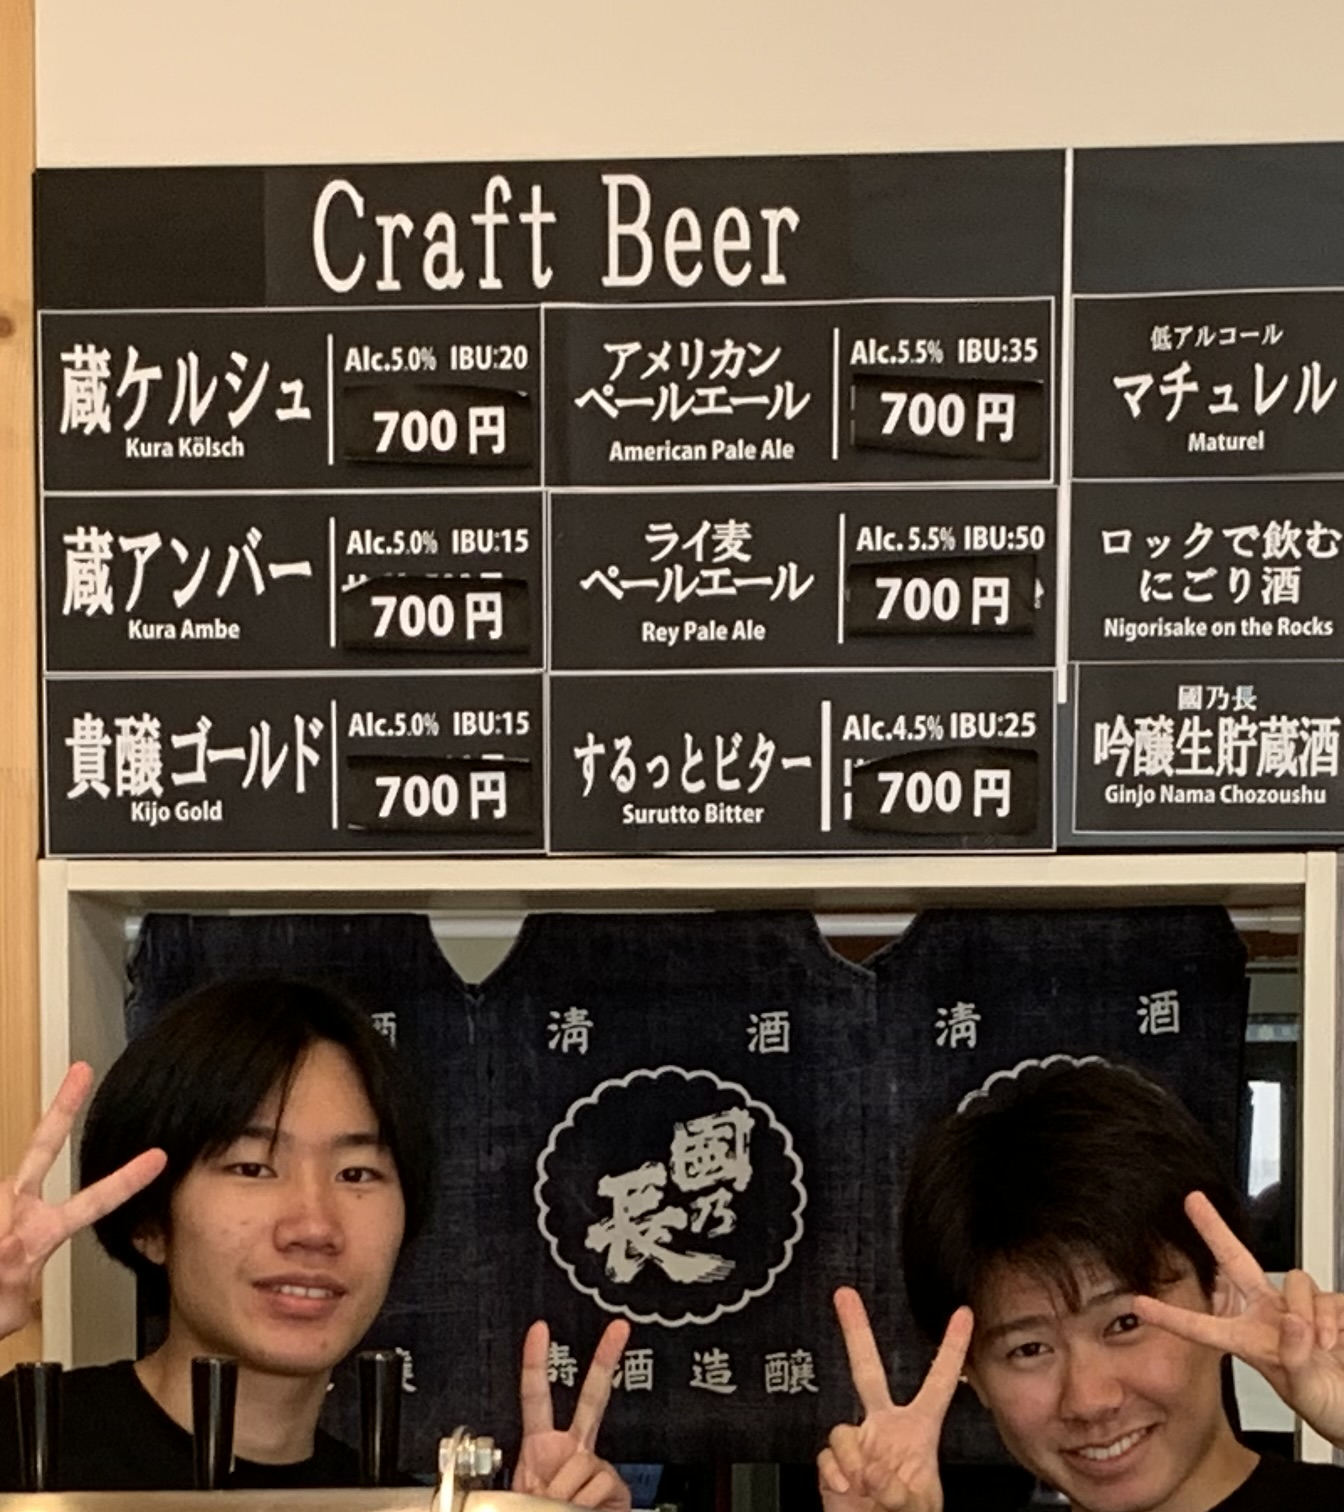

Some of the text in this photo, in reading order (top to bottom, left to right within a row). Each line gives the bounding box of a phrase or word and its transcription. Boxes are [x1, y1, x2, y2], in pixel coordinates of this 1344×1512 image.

[313, 174, 799, 292] Craft Beer
[1151, 324, 1283, 350] 低アルコール
[345, 345, 528, 371] Alc.5.0% IBU:20
[604, 339, 781, 380] アメリカン
[851, 338, 1037, 364] Alc.5.5% IBU:35
[60, 344, 311, 435] 蔵ケルシュ
[575, 379, 810, 421] ペールエール
[1114, 361, 1337, 421] マチュレル
[126, 436, 244, 457] Kura Kölsch
[610, 439, 794, 461] American Pale Ale
[1189, 430, 1264, 451] Maturel
[347, 529, 528, 554] Alc.5.0% IBU:15
[645, 519, 751, 562] ライ麦
[965, 526, 1045, 550] IBU:50
[1102, 520, 1342, 560] ロックで飲む
[63, 526, 311, 616] 蔵アンバー
[580, 562, 814, 602] ペールエール
[1140, 566, 1301, 605] にごり酒
[129, 618, 240, 639] Kura Ambe
[643, 620, 765, 646] Rey Pale Ale
[1105, 616, 1333, 641] Nigorisake on the Rocks
[349, 711, 529, 737] Alc.5.0% IBU:15
[843, 712, 1036, 741] Alc.4.5% IBU:25
[574, 733, 811, 796] するっとビター
[1105, 784, 1326, 806] Ginjo Nama Chozoushu
[132, 800, 222, 826] Kijo Gold
[623, 803, 764, 823] Surutto Bitter
